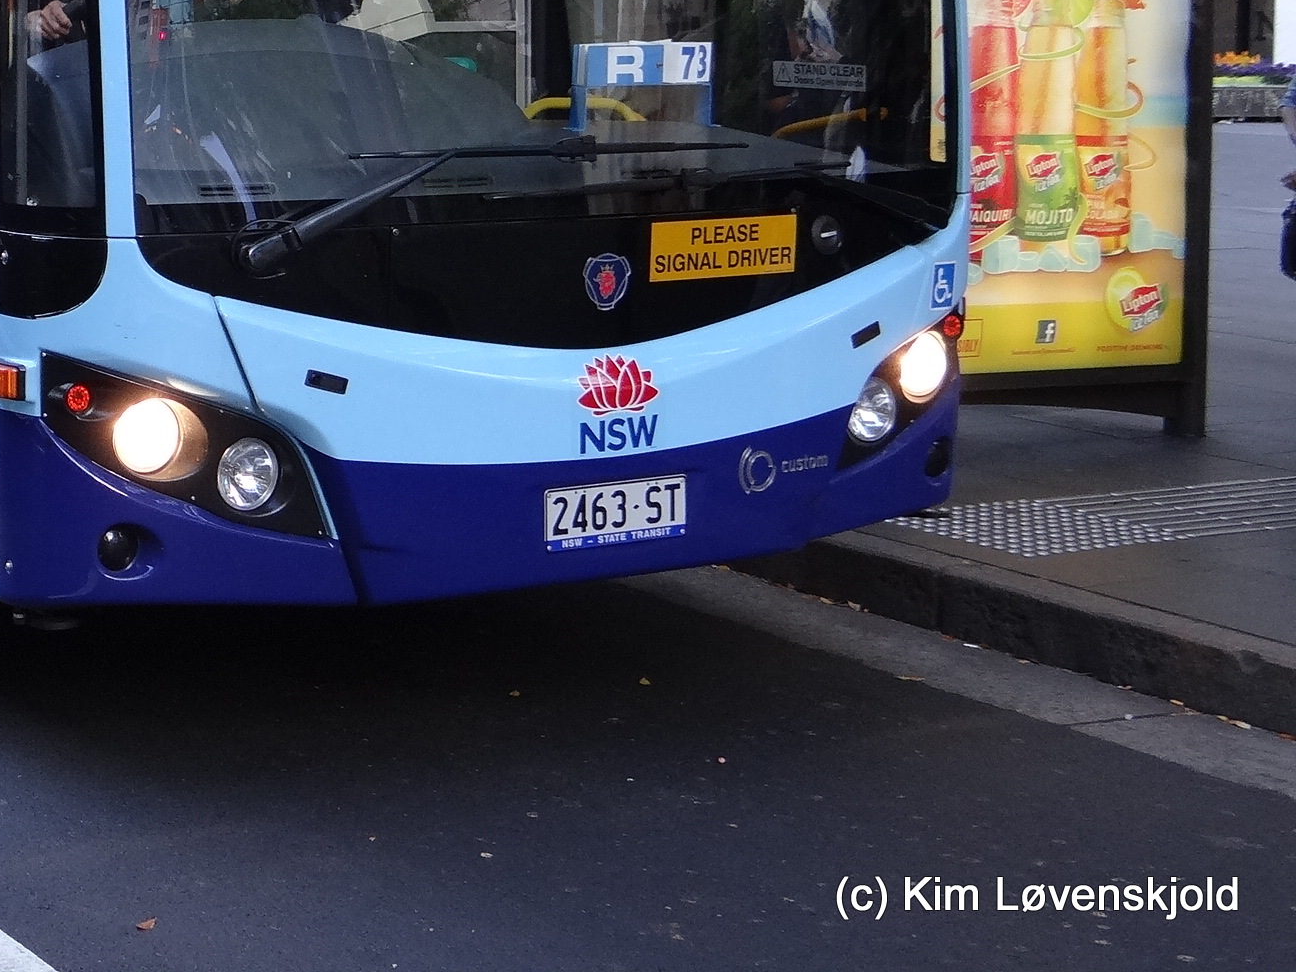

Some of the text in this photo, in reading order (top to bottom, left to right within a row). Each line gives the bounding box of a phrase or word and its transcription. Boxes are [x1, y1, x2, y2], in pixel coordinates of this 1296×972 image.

[607, 46, 644, 84] R
[681, 44, 707, 80] 73
[793, 63, 864, 78] STAND CLEAR
[1027, 157, 1058, 176] Lipton
[1087, 157, 1116, 175] Lipton
[970, 208, 1014, 223] AIQUIRI
[1025, 208, 1074, 225] MOJITO
[691, 223, 760, 245] PLEASE
[654, 246, 792, 274] SIGNAL DRIVER
[1123, 290, 1160, 312] Lipton
[579, 414, 659, 455] NSW
[561, 538, 583, 549] NSW
[597, 531, 627, 544] STATE
[630, 527, 672, 541] TRANSIT
